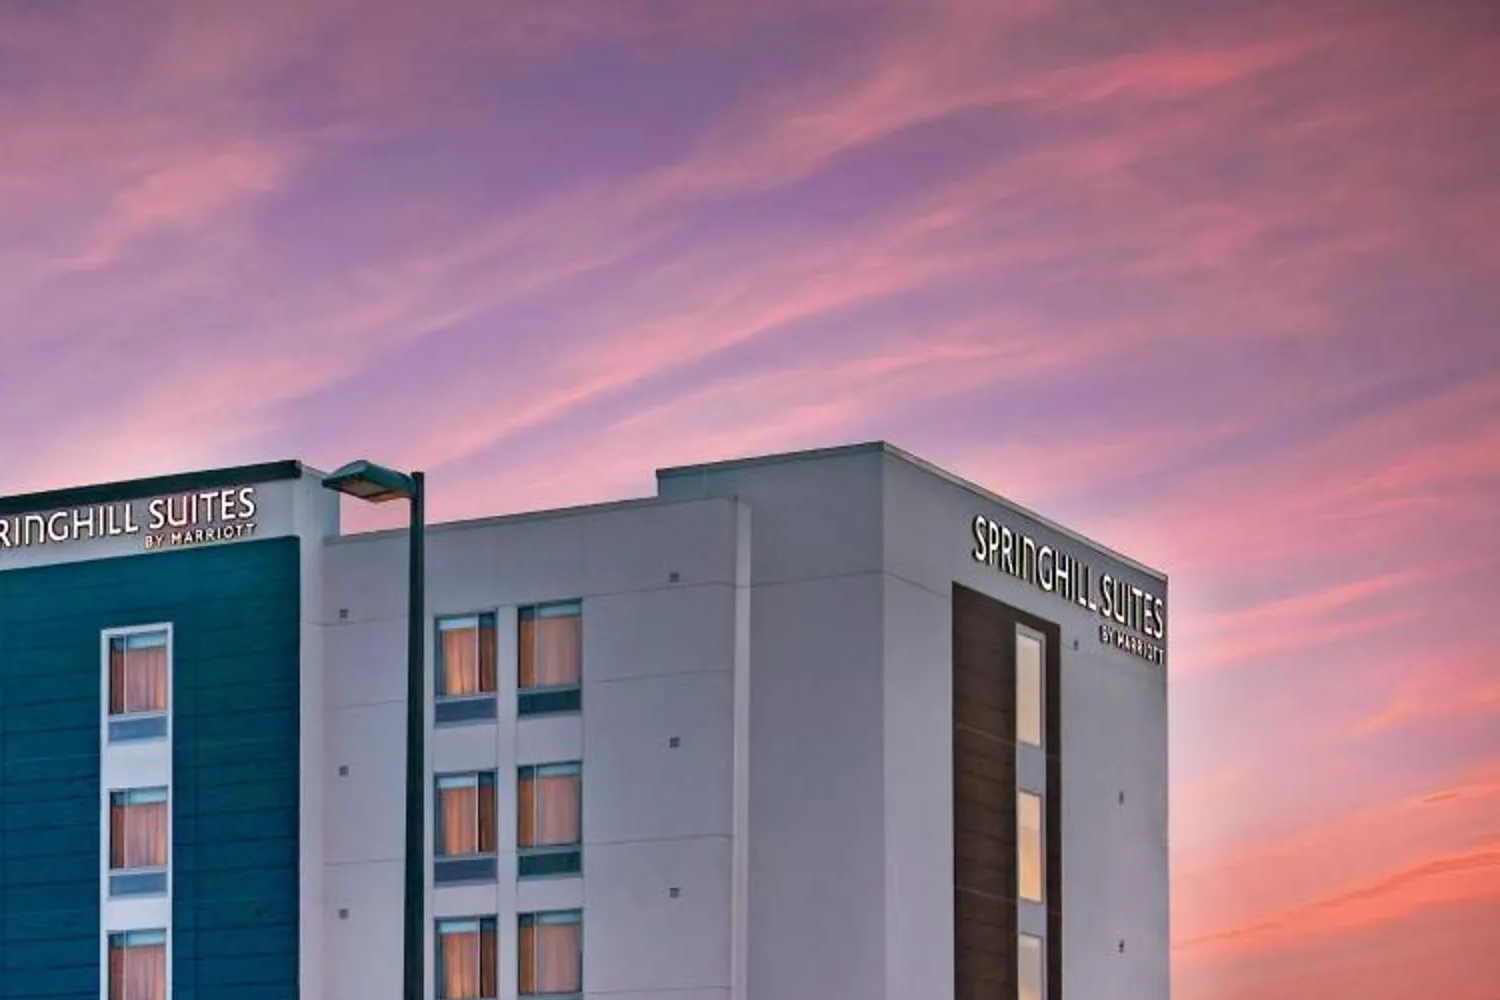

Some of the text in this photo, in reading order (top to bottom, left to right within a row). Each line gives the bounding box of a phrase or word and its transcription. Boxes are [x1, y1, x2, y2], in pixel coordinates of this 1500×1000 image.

[148, 487, 256, 530] SUITES
[145, 523, 256, 549] BY MARRIOTT
[972, 514, 1164, 640] SPRINGHILL SUITES
[1101, 625, 1164, 665] BY MARRIOTT
